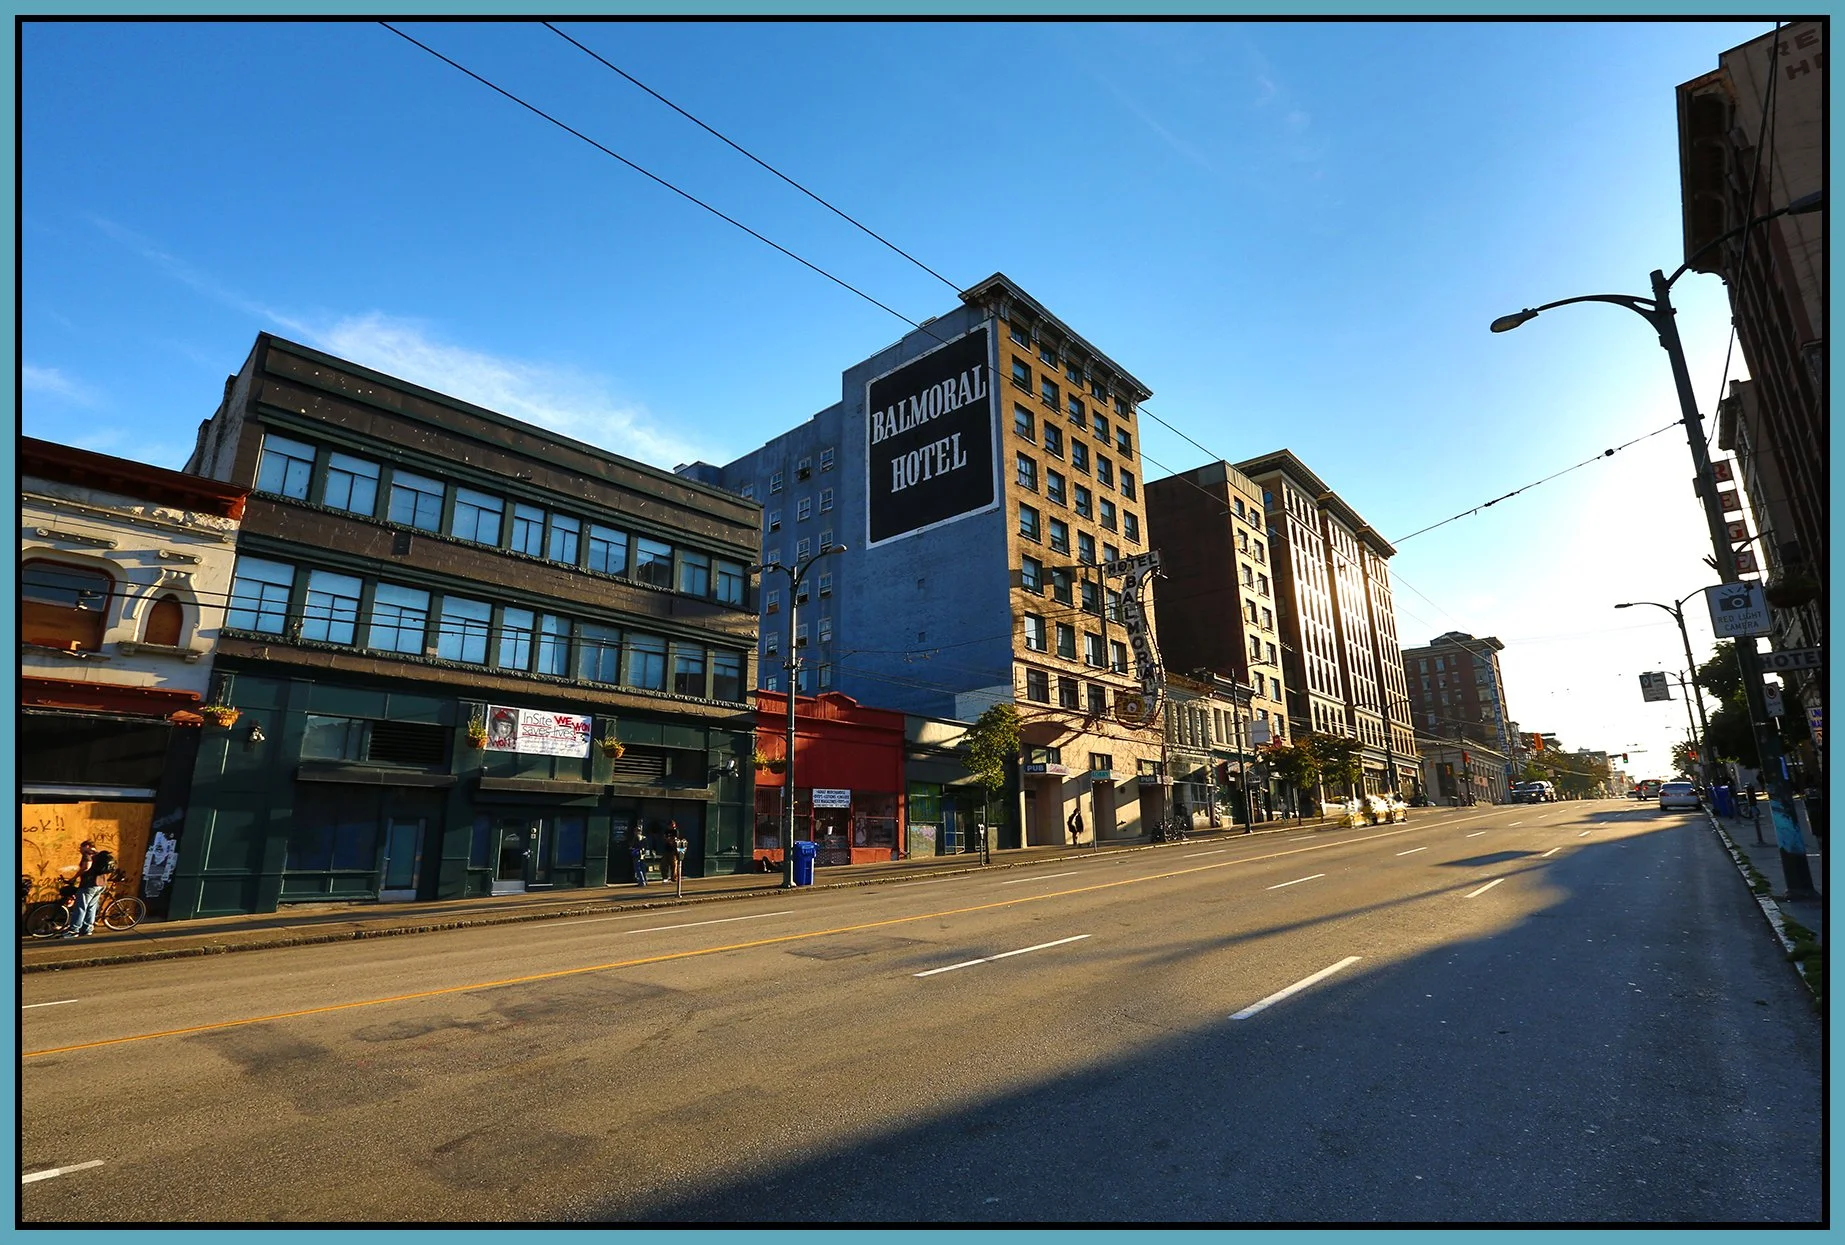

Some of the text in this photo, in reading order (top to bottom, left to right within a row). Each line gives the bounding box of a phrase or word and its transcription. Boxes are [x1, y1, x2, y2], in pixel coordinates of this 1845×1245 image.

[871, 364, 986, 445] BALMORAL
[891, 432, 967, 493] HOTEL
[1107, 551, 1158, 573] HOTEL
[1717, 611, 1762, 624] RED LIGHT
[1724, 621, 1760, 632] CAMERA
[1122, 575, 1155, 695] BALMORAL
[523, 712, 553, 727] InSite
[554, 716, 573, 726] WE
[522, 725, 550, 737] saves
[1026, 764, 1044, 772] PUB
